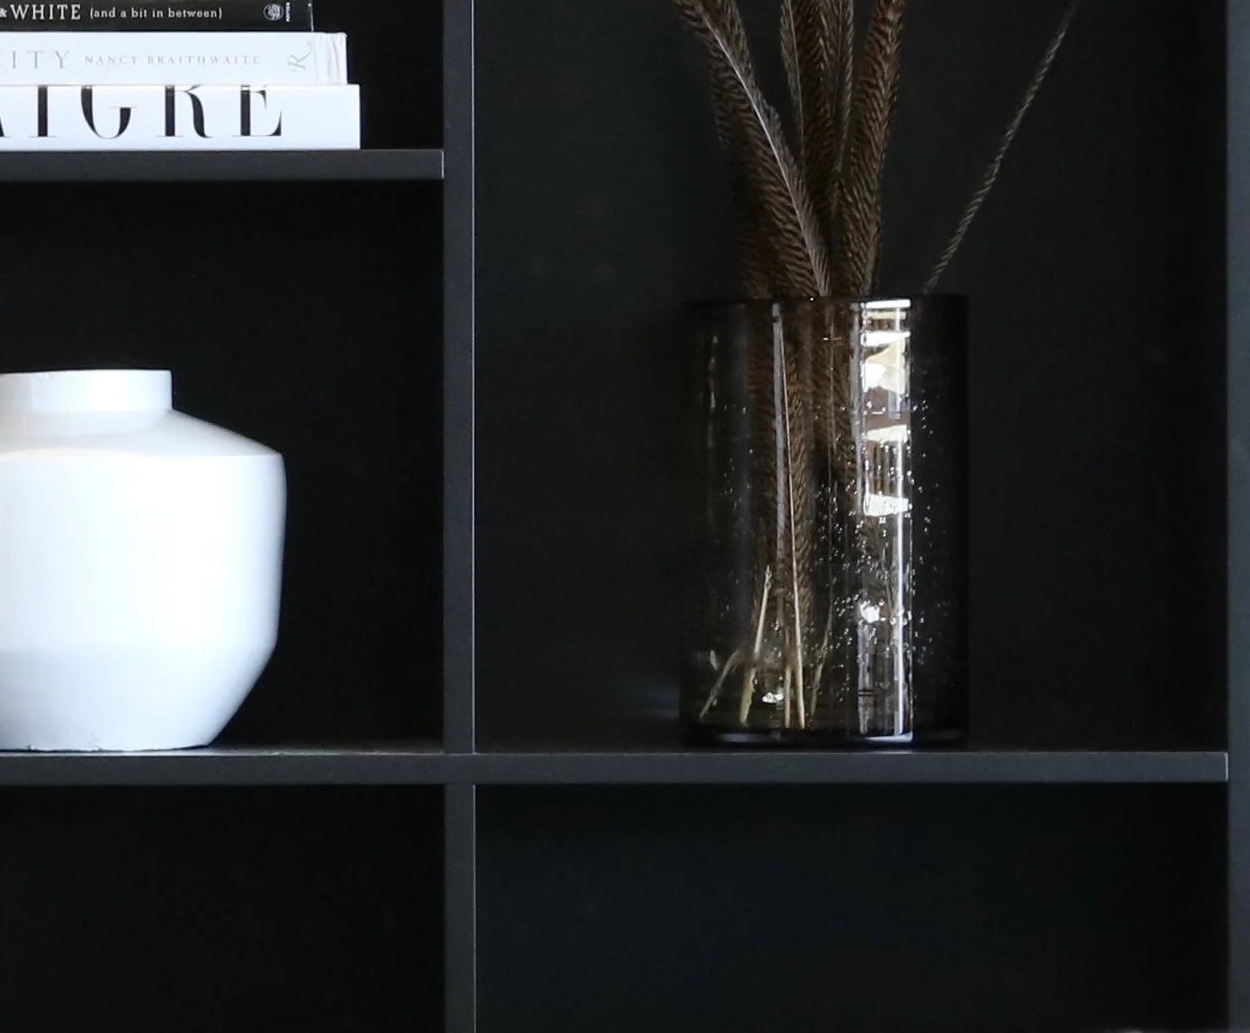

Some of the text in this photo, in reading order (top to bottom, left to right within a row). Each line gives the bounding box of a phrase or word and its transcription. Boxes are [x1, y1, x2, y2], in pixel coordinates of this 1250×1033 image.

[90, 7, 116, 20] (and
[120, 9, 127, 18] a
[131, 6, 148, 18] bit
[152, 7, 164, 18] in
[168, 6, 223, 20] between)
[84, 55, 138, 65] NANCY
[147, 55, 259, 65] BRAITHWAITE
